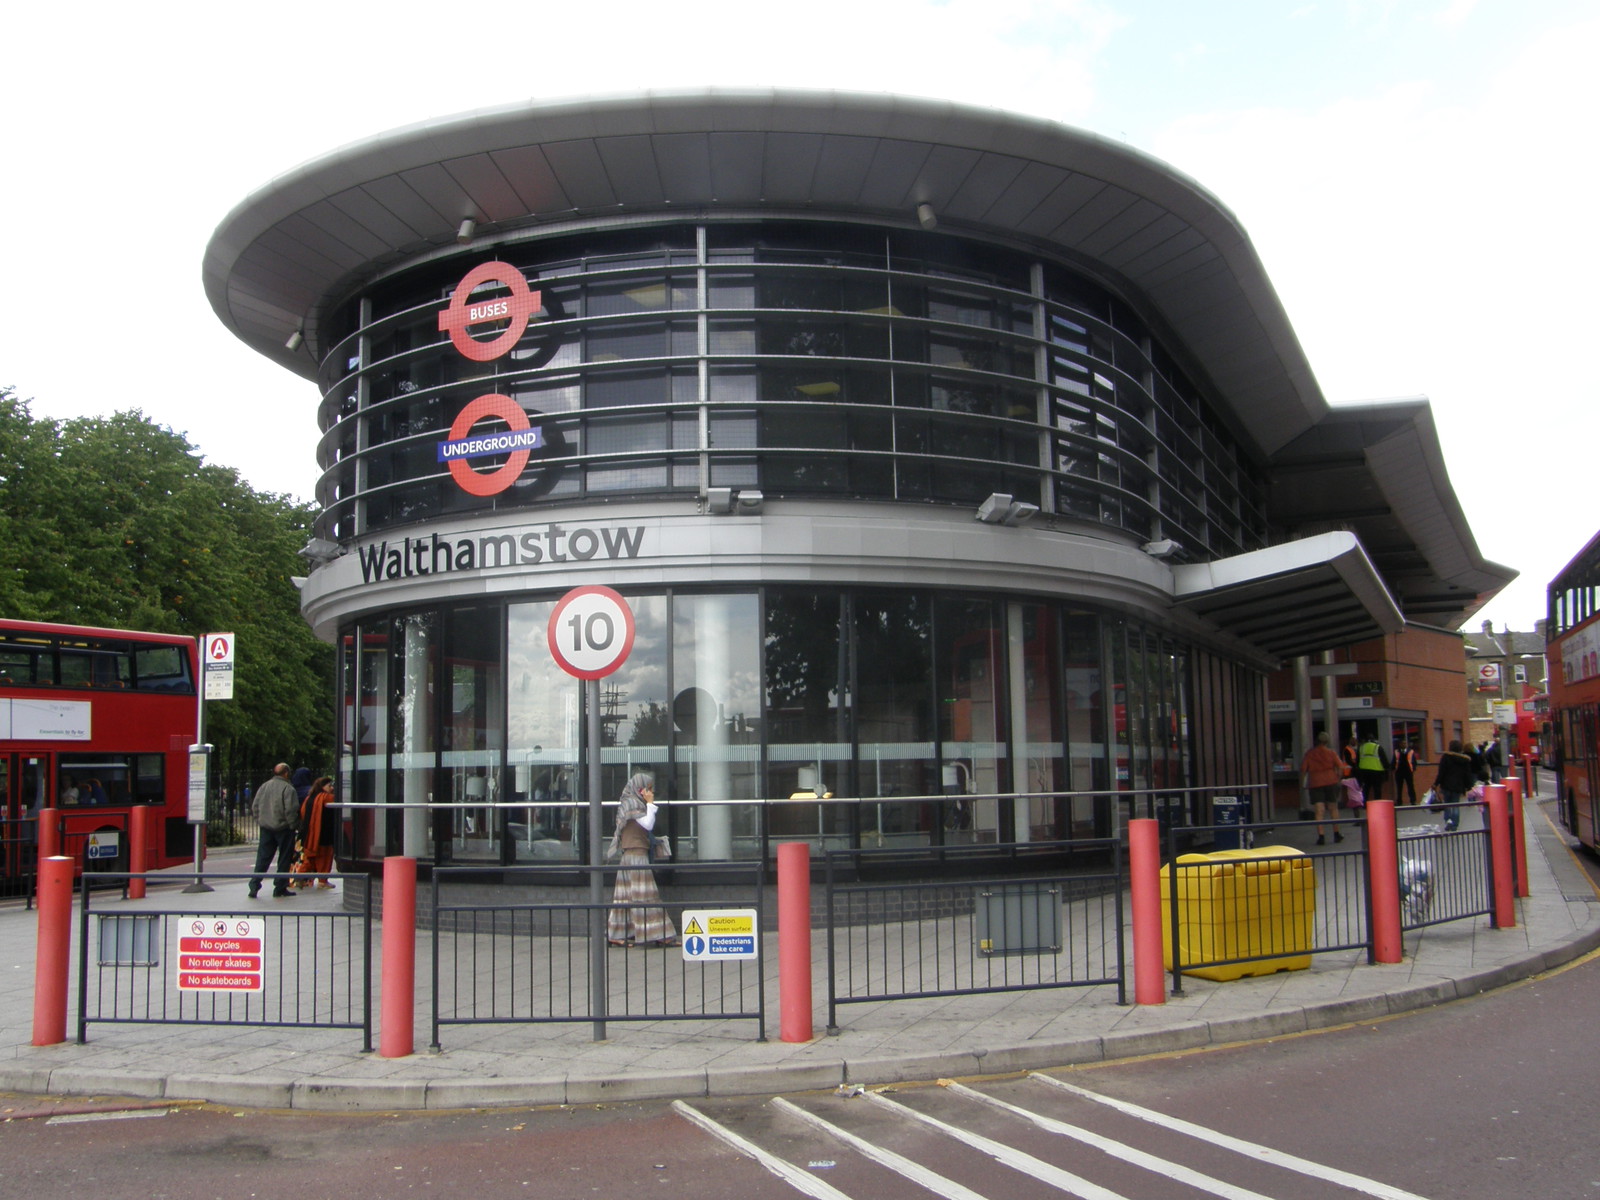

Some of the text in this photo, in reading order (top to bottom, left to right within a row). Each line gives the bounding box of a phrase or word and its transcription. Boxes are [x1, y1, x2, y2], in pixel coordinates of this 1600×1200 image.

[470, 302, 508, 320] BUSES
[443, 432, 536, 457] UNDERGROUND
[358, 523, 646, 584] Walthamstow
[567, 611, 615, 652] 10
[213, 639, 226, 657] A
[200, 940, 241, 952] No cycles
[188, 957, 252, 968] No roller skates
[188, 975, 252, 986] No skateboards
